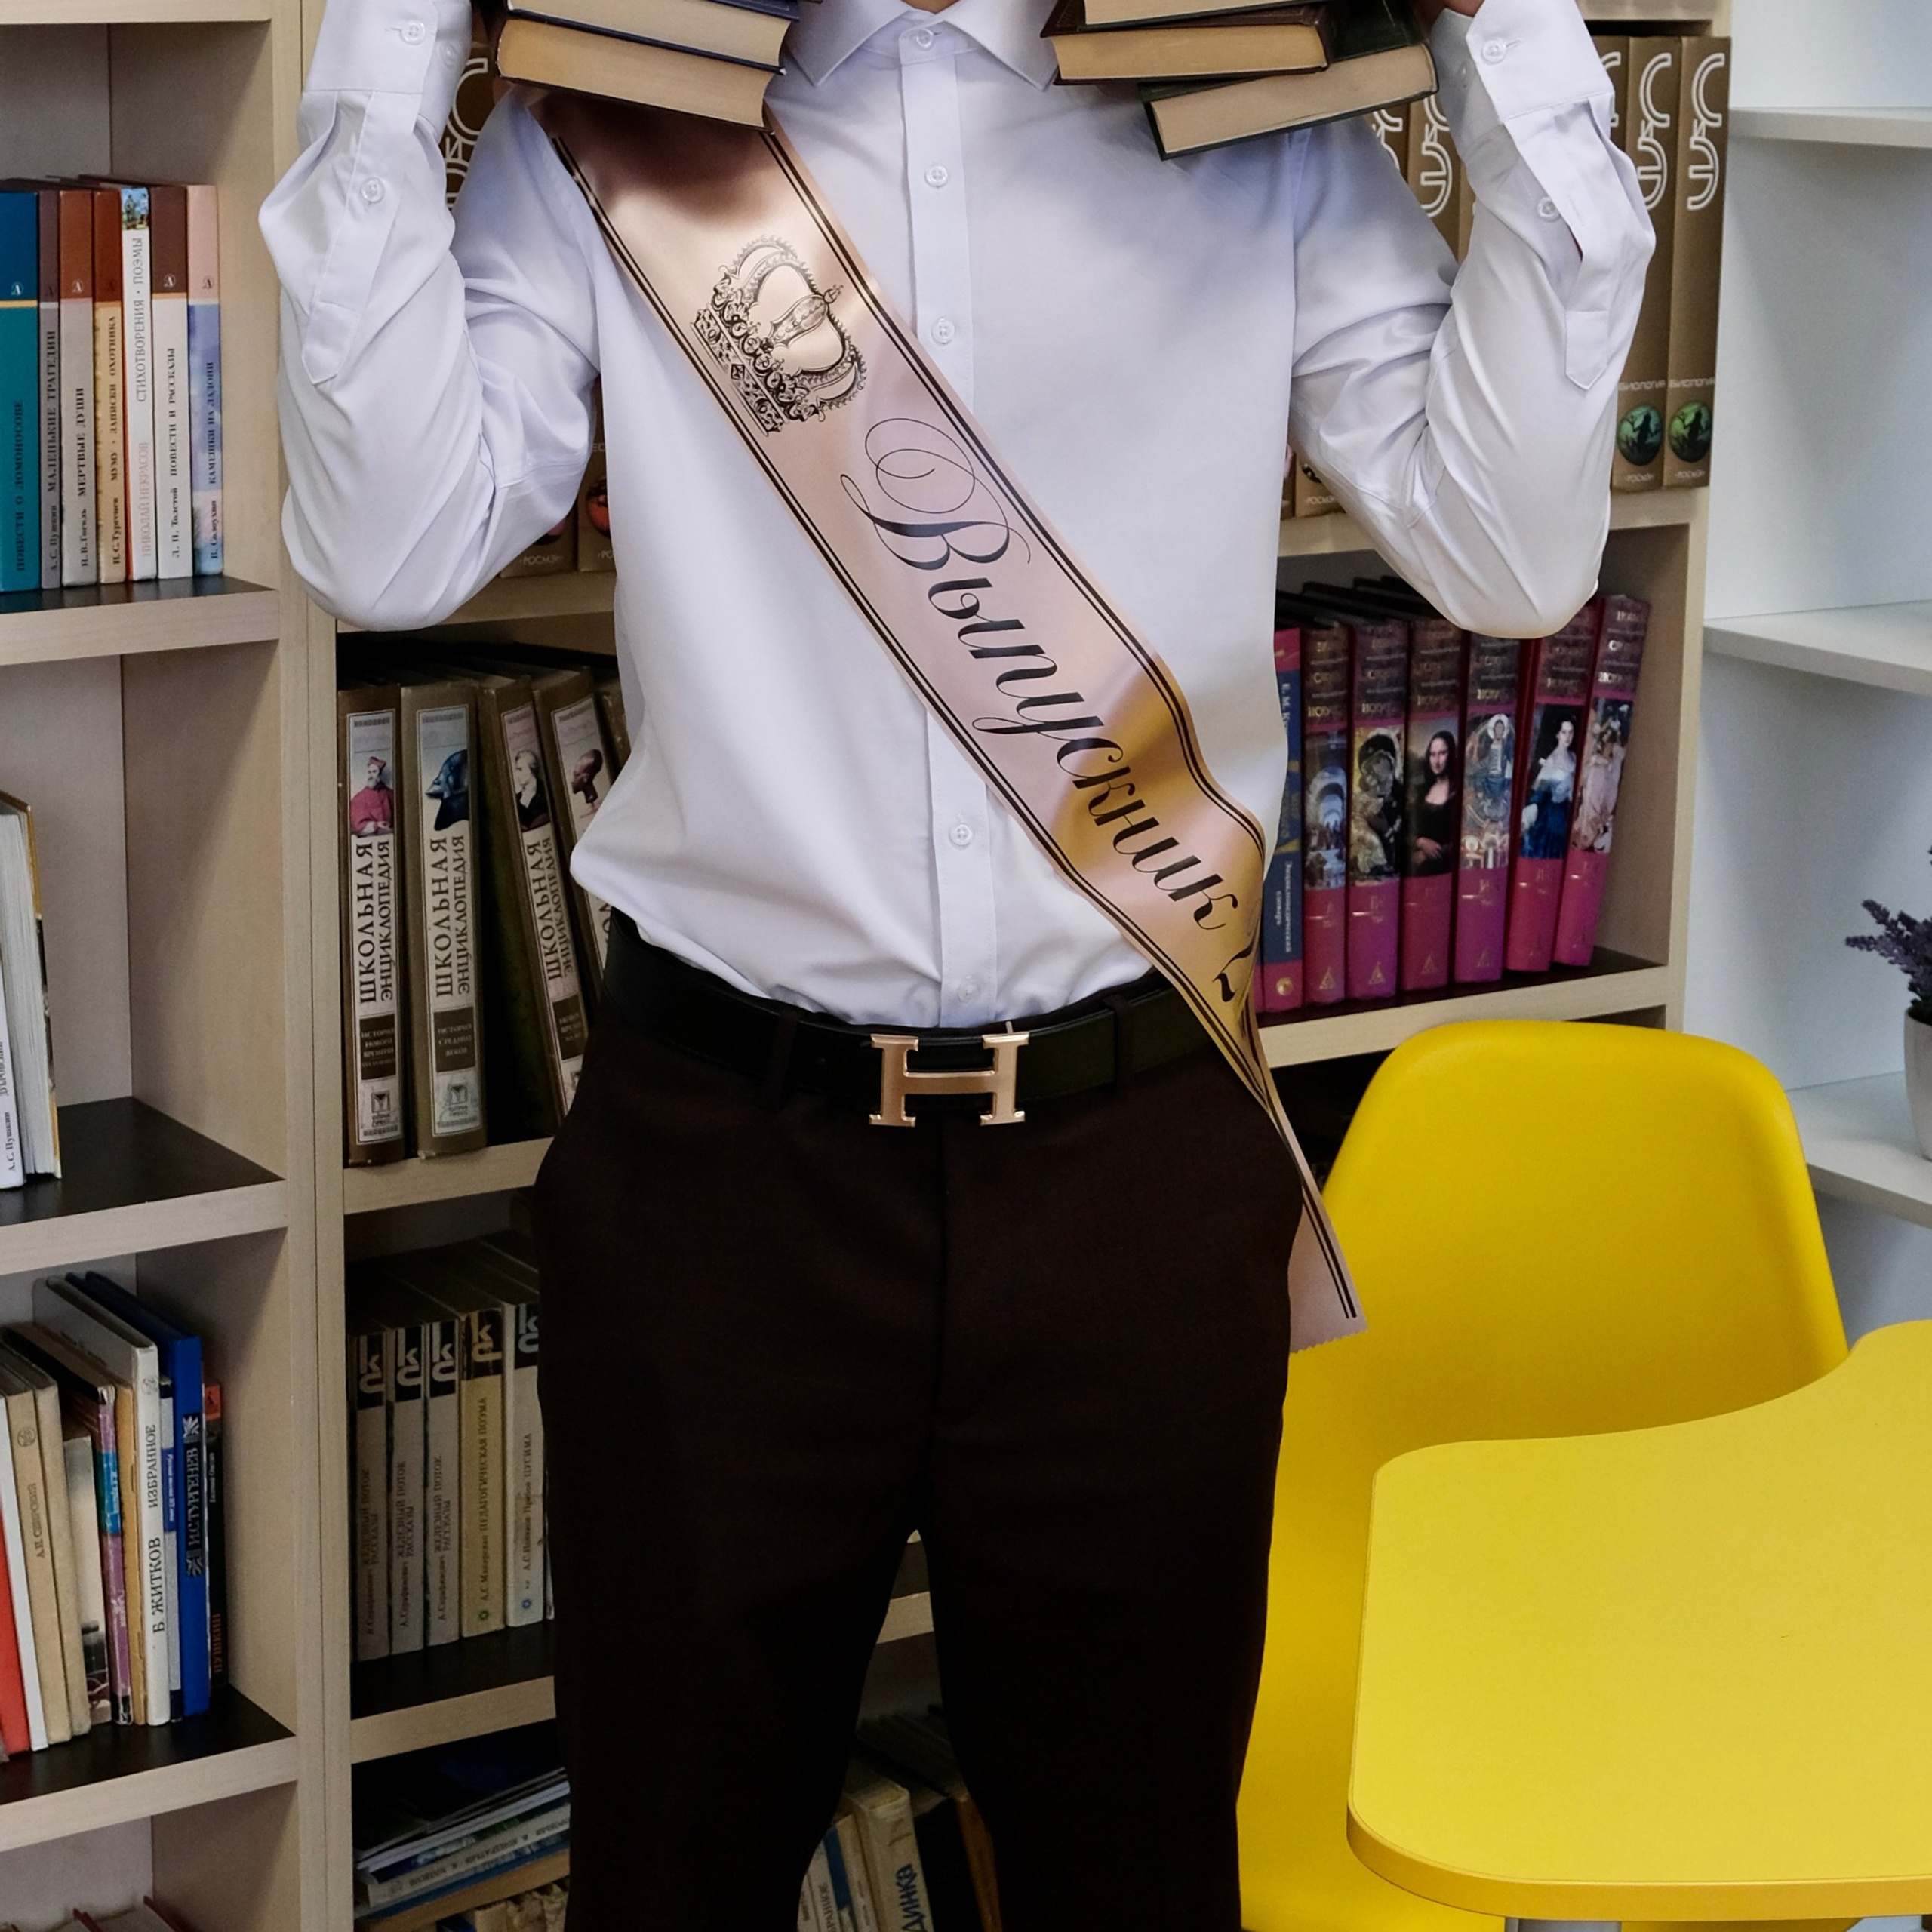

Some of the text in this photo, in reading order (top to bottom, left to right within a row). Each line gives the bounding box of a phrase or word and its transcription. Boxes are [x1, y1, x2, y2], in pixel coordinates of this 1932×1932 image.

[45, 331, 59, 402] ТРАГЕДИИ
[108, 316, 118, 377] ОХОТНИКА
[166, 347, 177, 405] РАССКАЗЫ
[75, 387, 87, 429] ДУШИ
[109, 383, 118, 435] ЗАПИСКИ
[131, 237, 152, 557] НИКОЛАЙ НЕКРАСОВ СТИХОТВОРЕНИЯ ПОЭМЫ
[206, 361, 217, 408] ЛАДОНИ
[14, 398, 26, 490] ЛОМОНОСОВЕ
[46, 408, 60, 493] МАЛЕНЬКИЕ
[75, 432, 87, 497] МЕРТВЫЕ
[109, 451, 119, 482] МУМУ
[168, 423, 179, 477] ПОВЕСТИ
[208, 429, 217, 485] КАМЕШКИ
[170, 487, 180, 526] Толстой
[14, 511, 26, 572] ПОВЕСТИ
[840, 417, 1238, 930] Выпускник
[355, 843, 378, 1004] ШКОЛЬНАЯ
[377, 841, 395, 1001] ЭНЦИКЛОПЕДИЯ
[429, 837, 454, 998] ШКОЛЬНАЯ
[451, 835, 471, 995] ЭНЦИКЛОПЕДИЯ
[527, 844, 564, 980] ШКОЛЬНАЯ
[541, 837, 574, 975] ЭНЦИКЛОПЕДИЯ
[478, 1397, 488, 1435] ПОЭМА
[146, 1424, 159, 1509] ИЗБРАННОЕ
[360, 1467, 371, 1504] ПОТОК
[395, 1460, 406, 1497] ПОТОК
[432, 1455, 442, 1492] ПОТОК
[478, 1438, 489, 1532] ПЕДАГОГИЧЕСКАЯ
[369, 1513, 379, 1565] РАССКАЗЫ
[405, 1506, 415, 1558] РАССКАЗЫ
[441, 1500, 452, 1552] РАССКАЗЫ
[148, 1537, 165, 1617] ЖИТКОВ
